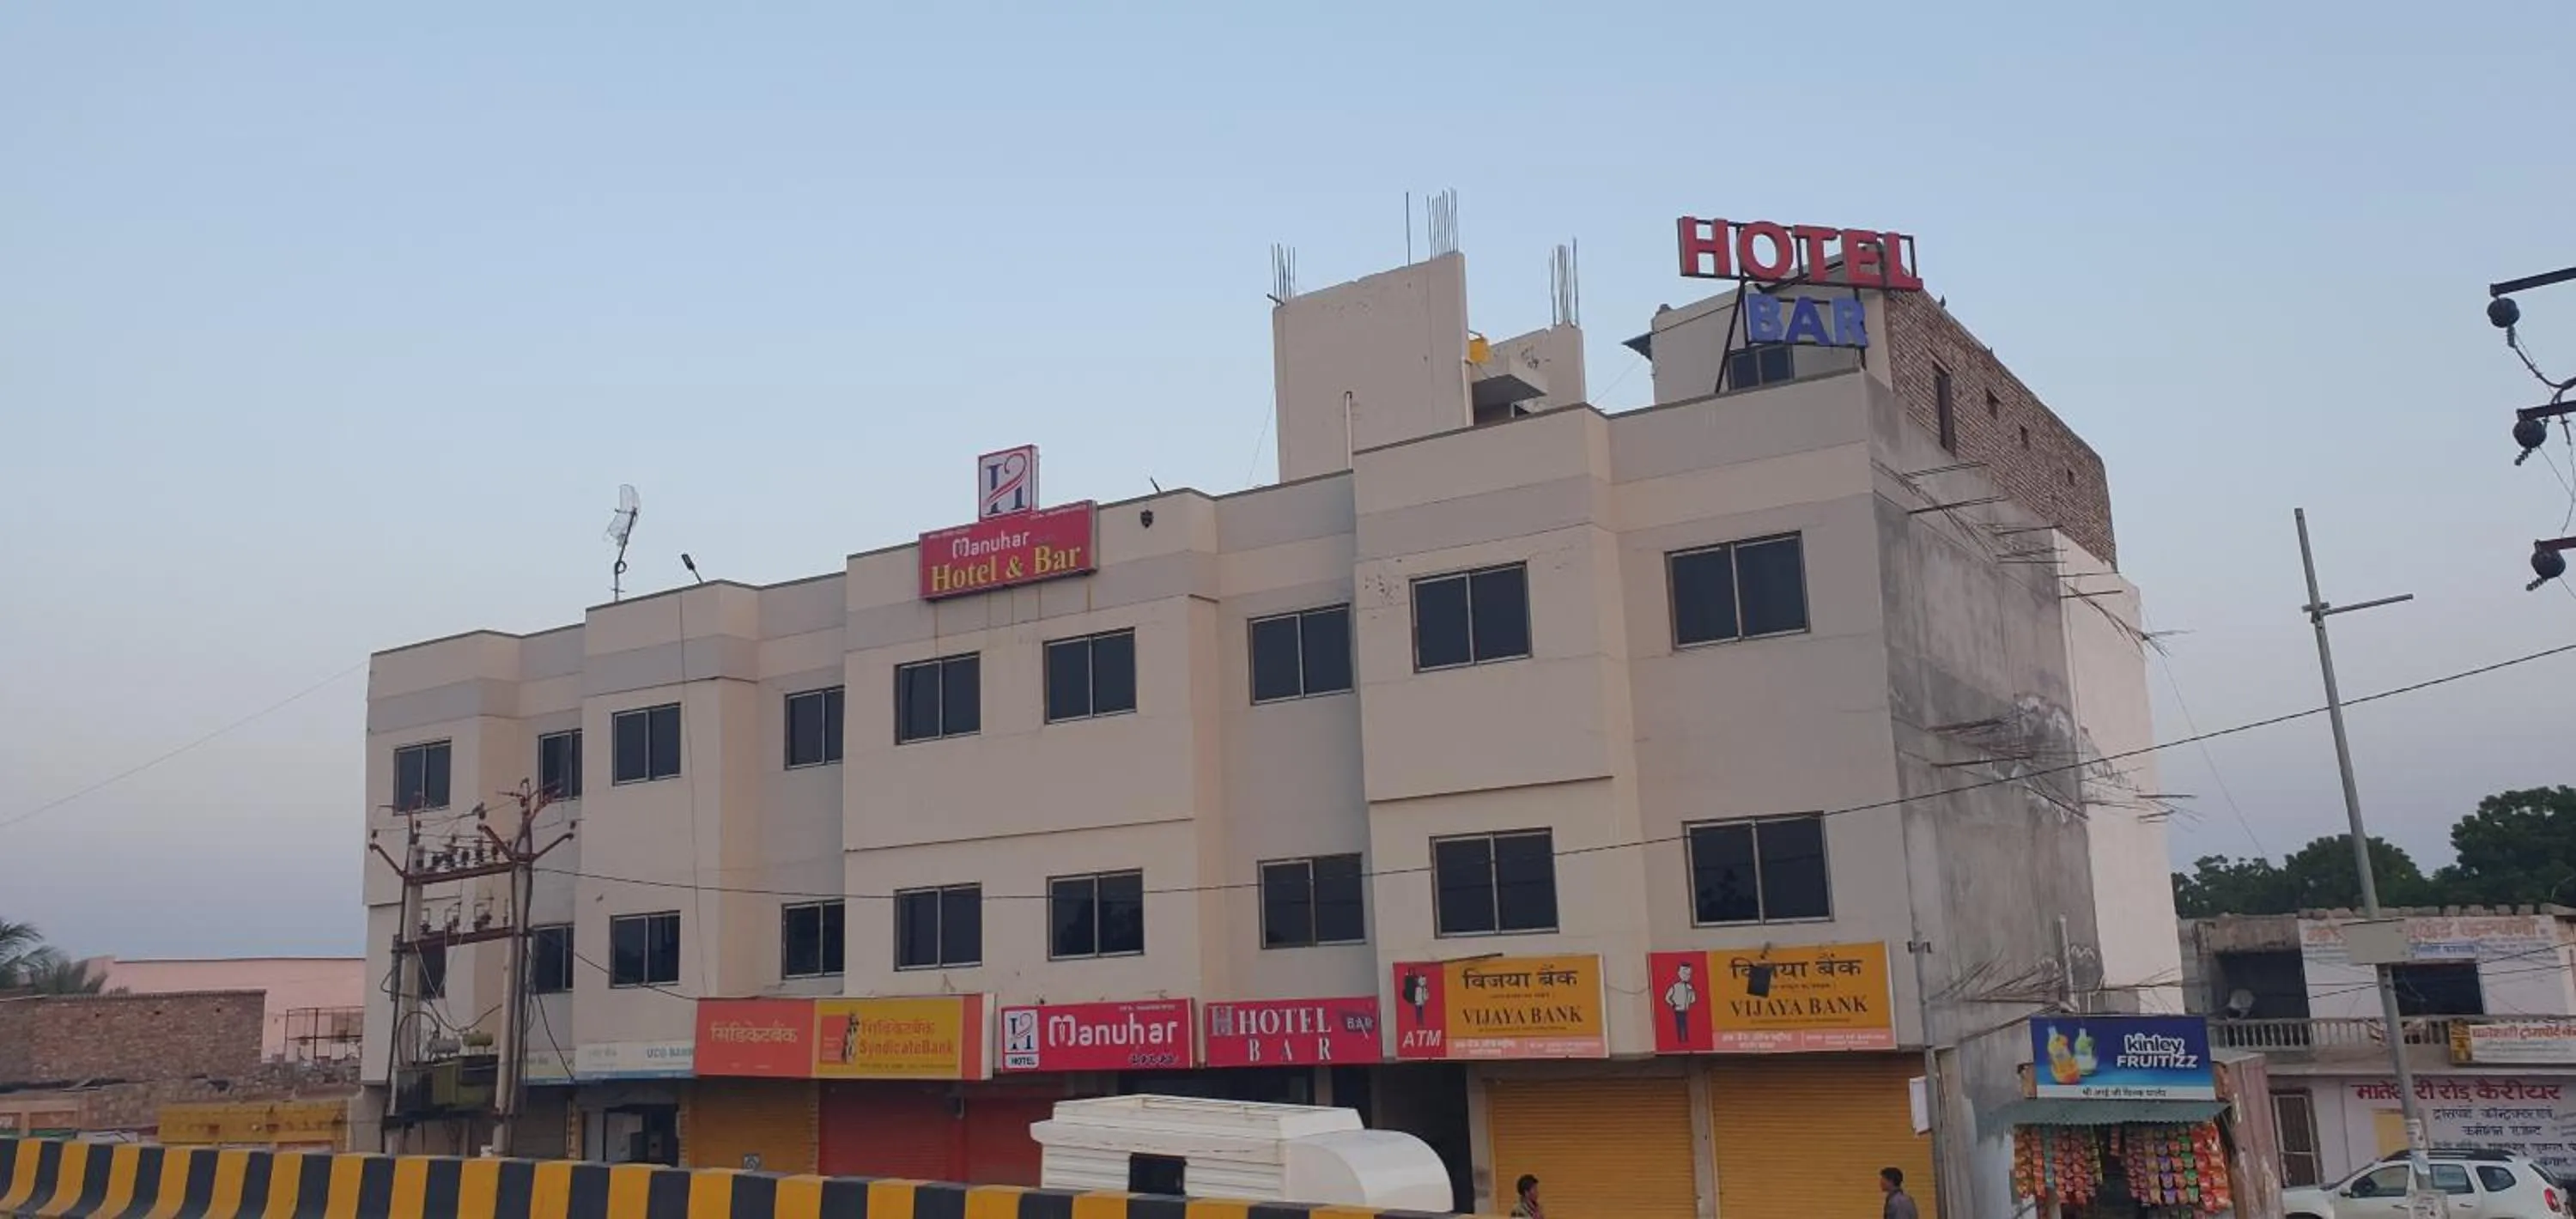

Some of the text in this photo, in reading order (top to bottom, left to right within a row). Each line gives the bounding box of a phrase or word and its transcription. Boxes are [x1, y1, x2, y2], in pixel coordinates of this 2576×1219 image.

[1677, 216, 1923, 291] HOTEL
[1747, 293, 1868, 348] BAR
[952, 530, 1030, 558] Manuhar
[932, 546, 1081, 591] Hotel & Bar
[1462, 964, 1578, 989] विजया बैंक
[1730, 952, 1862, 979] विया बैंक
[1462, 1005, 1583, 1025] VIJAYA BANK
[1730, 995, 1868, 1017] VIJAYA BANK
[1048, 1012, 1178, 1046] Manuhar
[1238, 1007, 1331, 1035] HOTEL
[1346, 1016, 1373, 1030] BAR
[1402, 1029, 1442, 1048] ATM
[2124, 1034, 2184, 1056] kinley
[1011, 1057, 1036, 1065] HOTEL
[2117, 1055, 2198, 1068] FRUITIZZ
[2475, 1079, 2562, 1100] कैरीयर
